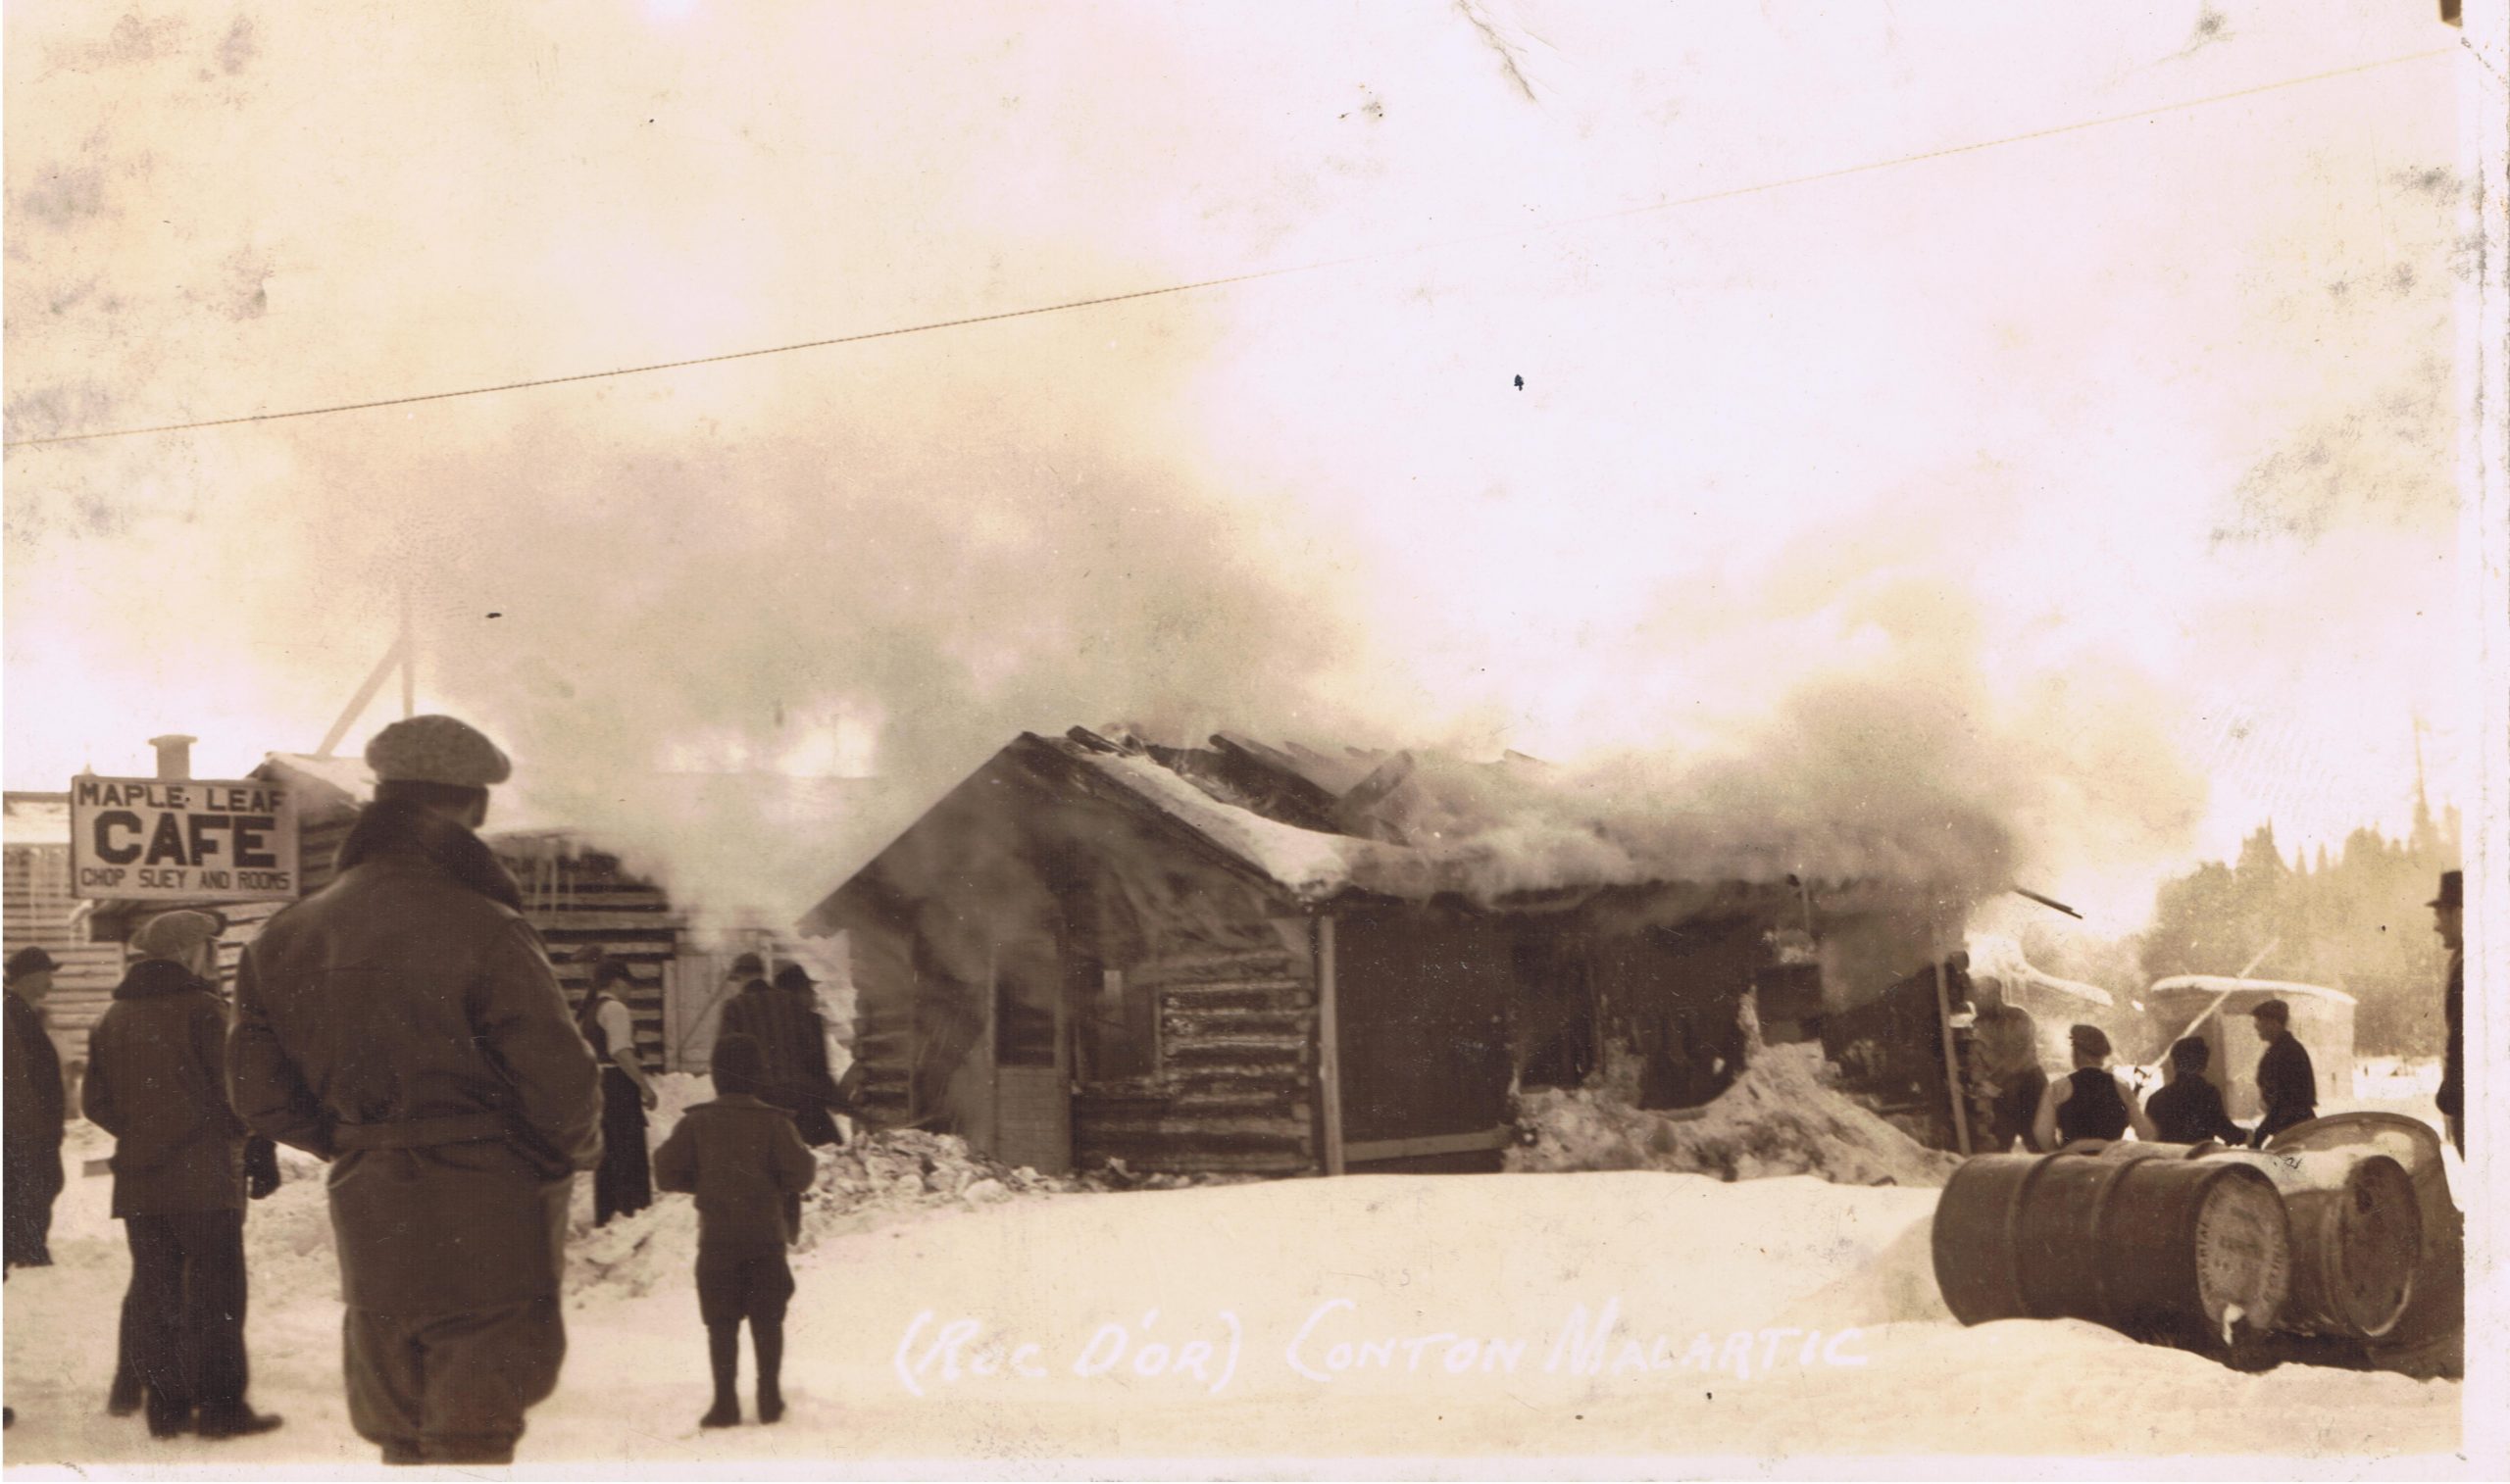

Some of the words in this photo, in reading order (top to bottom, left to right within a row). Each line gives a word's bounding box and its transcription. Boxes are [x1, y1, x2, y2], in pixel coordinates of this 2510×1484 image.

[207, 788, 285, 813] LEAF
[94, 811, 276, 867] CAFE
[80, 867, 126, 887] CHOP
[138, 868, 186, 888] SUEY
[199, 870, 229, 889] AND
[237, 871, 291, 890] ROOMS
